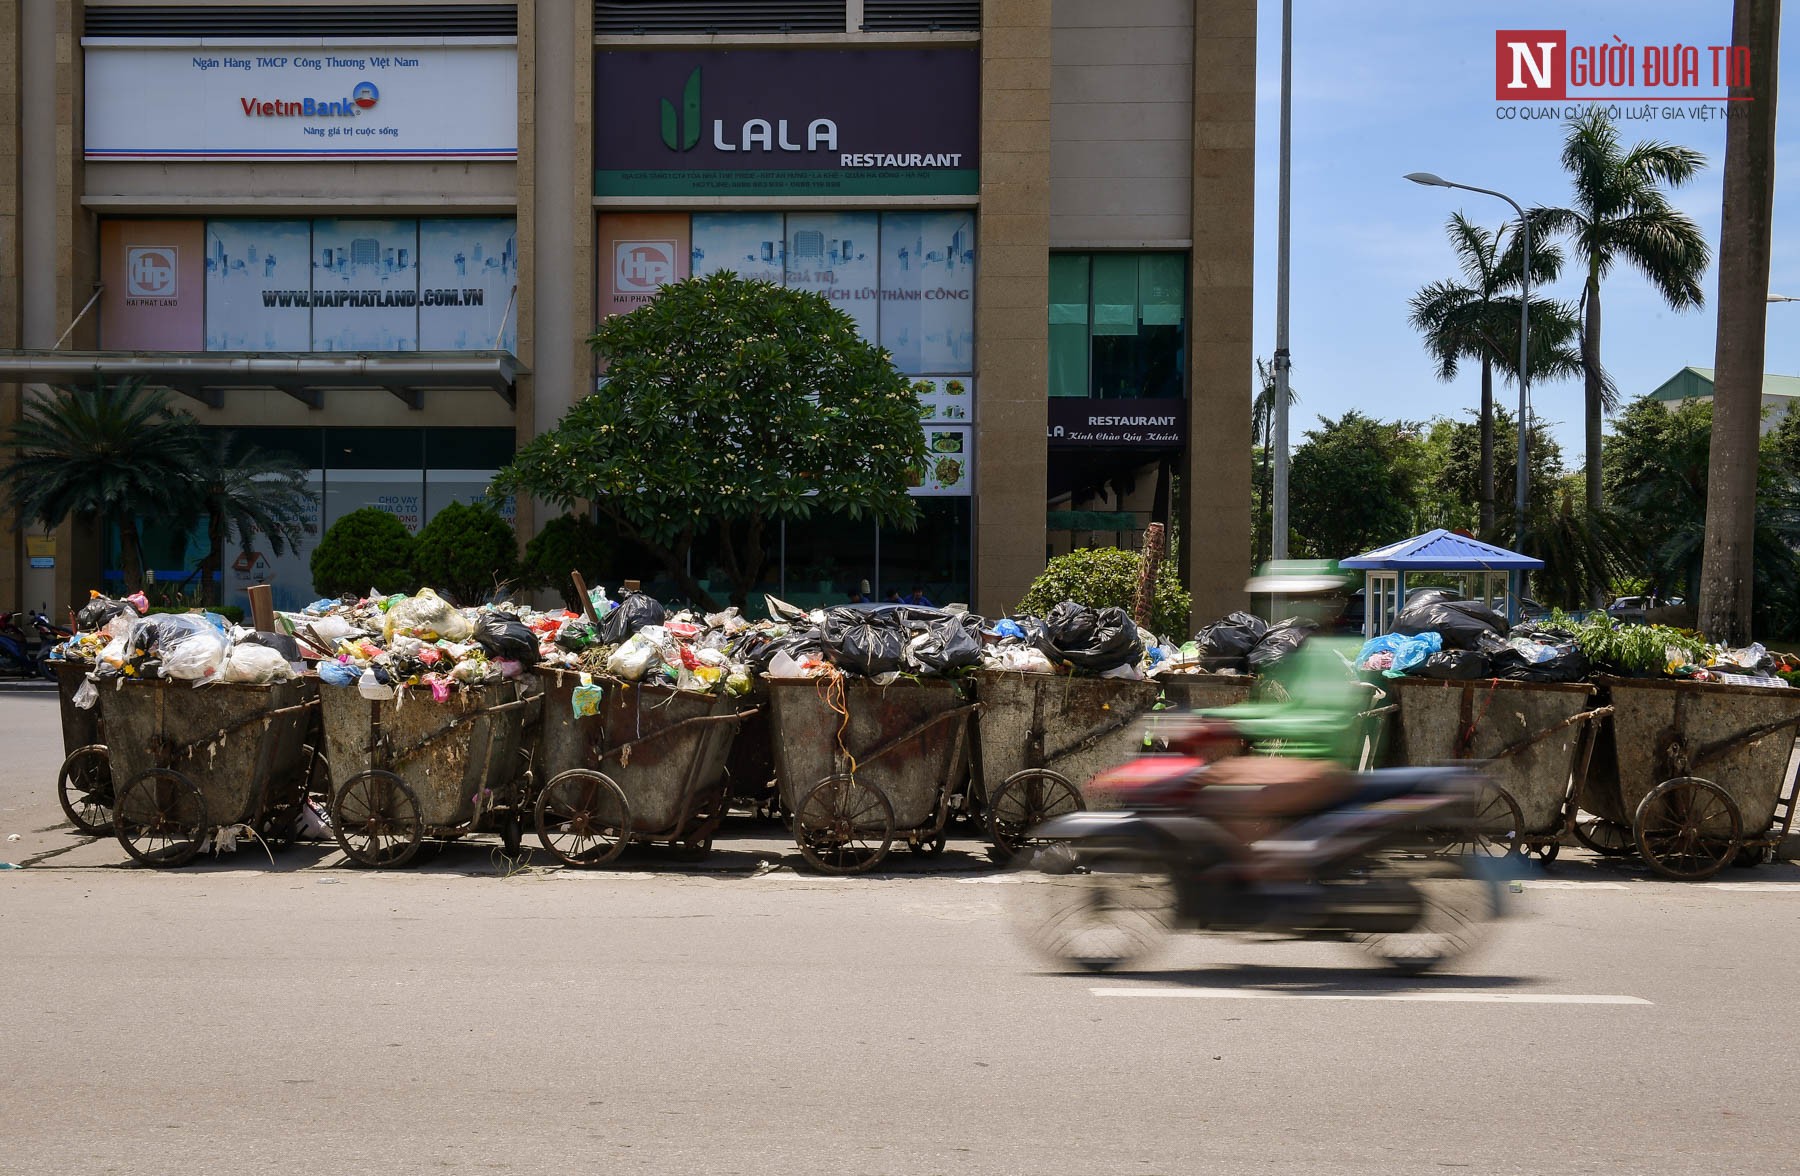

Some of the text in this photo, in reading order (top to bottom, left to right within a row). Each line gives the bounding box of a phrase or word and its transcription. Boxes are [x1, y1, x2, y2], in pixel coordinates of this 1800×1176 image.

[192, 57, 419, 70] Ngân Hàng TMCP Công Thương Việt Nam
[303, 126, 399, 138] Nâng giá trị cuộc sống
[714, 118, 838, 152] LALA
[840, 152, 962, 167] RESTAURANT
[881, 287, 922, 301] THÀNH
[924, 286, 969, 300] CÔNG
[159, 299, 178, 307] LAND
[1088, 416, 1176, 426] RESTAURANT
[1066, 431, 1094, 441] Kính
[1095, 431, 1121, 441] Chào
[1145, 431, 1180, 442] Khách
[378, 496, 418, 504] CHO VAY
